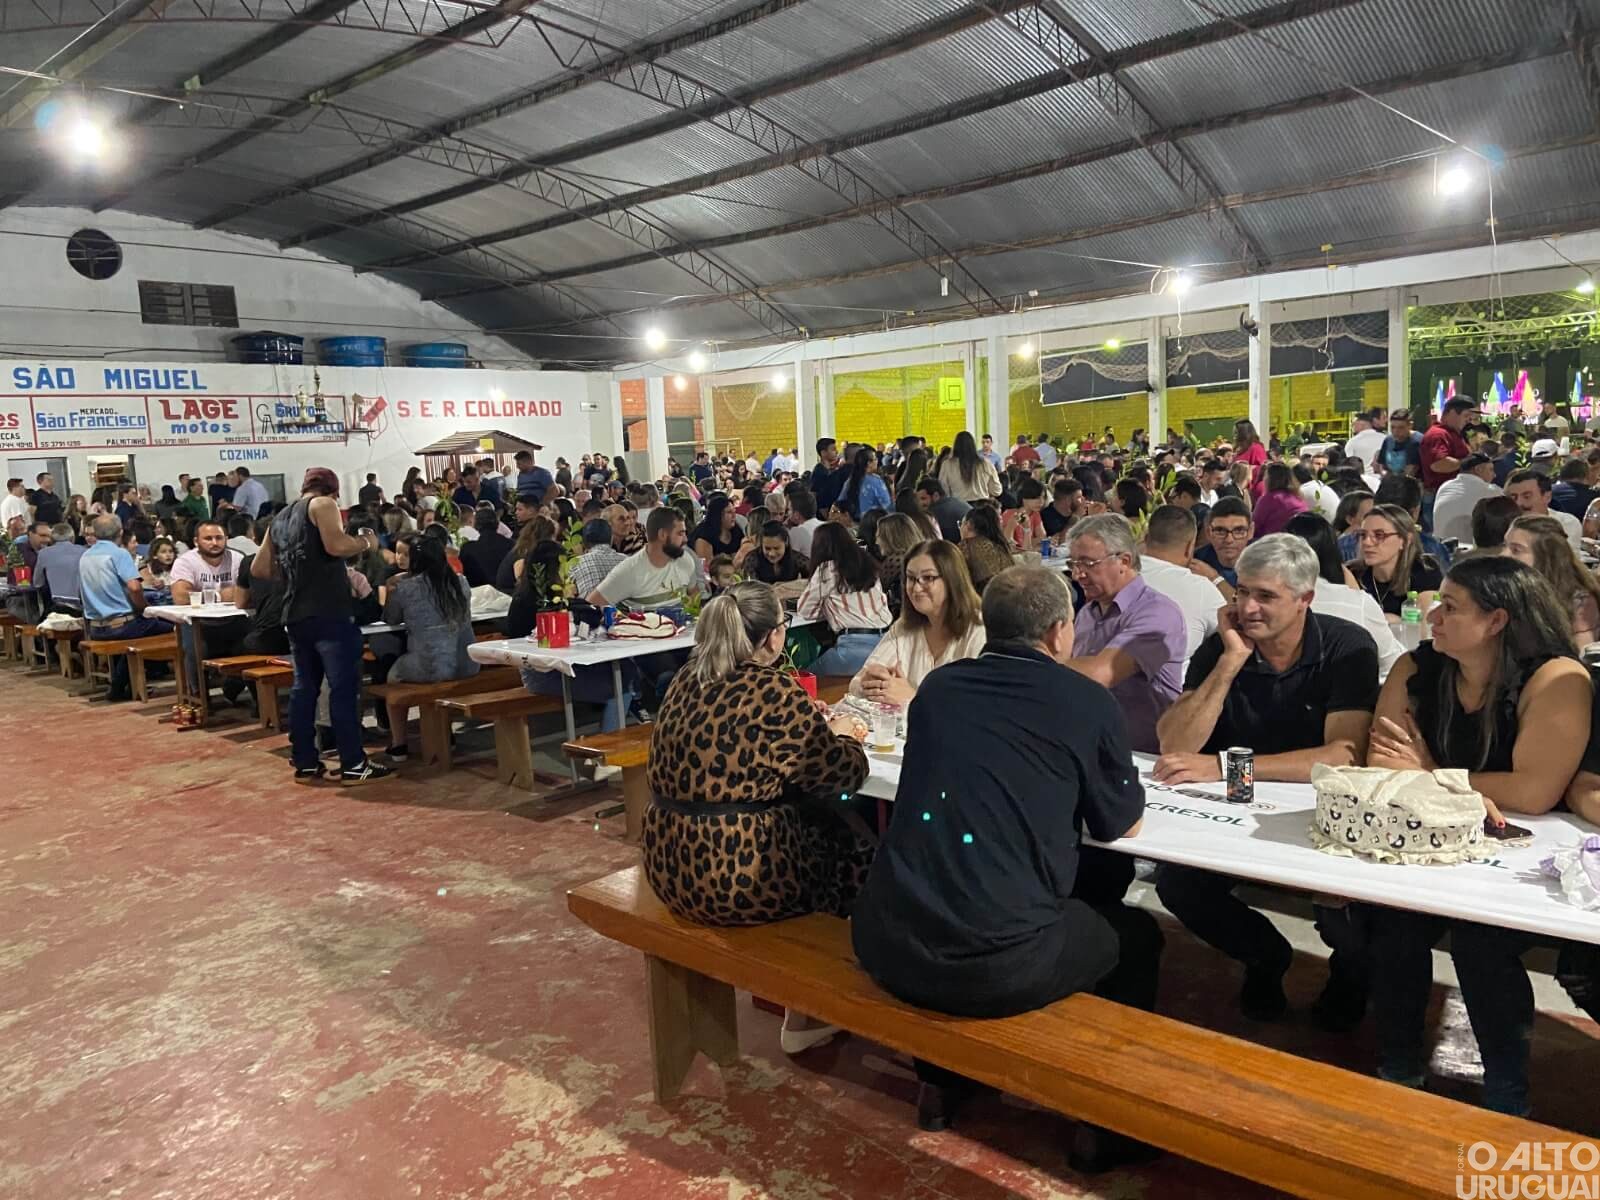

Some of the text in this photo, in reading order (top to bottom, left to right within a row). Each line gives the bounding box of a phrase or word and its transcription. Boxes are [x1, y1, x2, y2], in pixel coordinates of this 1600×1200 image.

[104, 368, 207, 390] MIGUEL
[159, 399, 239, 419] LAGE
[275, 403, 316, 418] GRUO
[465, 400, 562, 417] COLORADO
[69, 412, 146, 428] Francisco
[171, 421, 231, 434] motos
[219, 449, 269, 460] COZINHA
[1145, 802, 1247, 826] CRESOL
